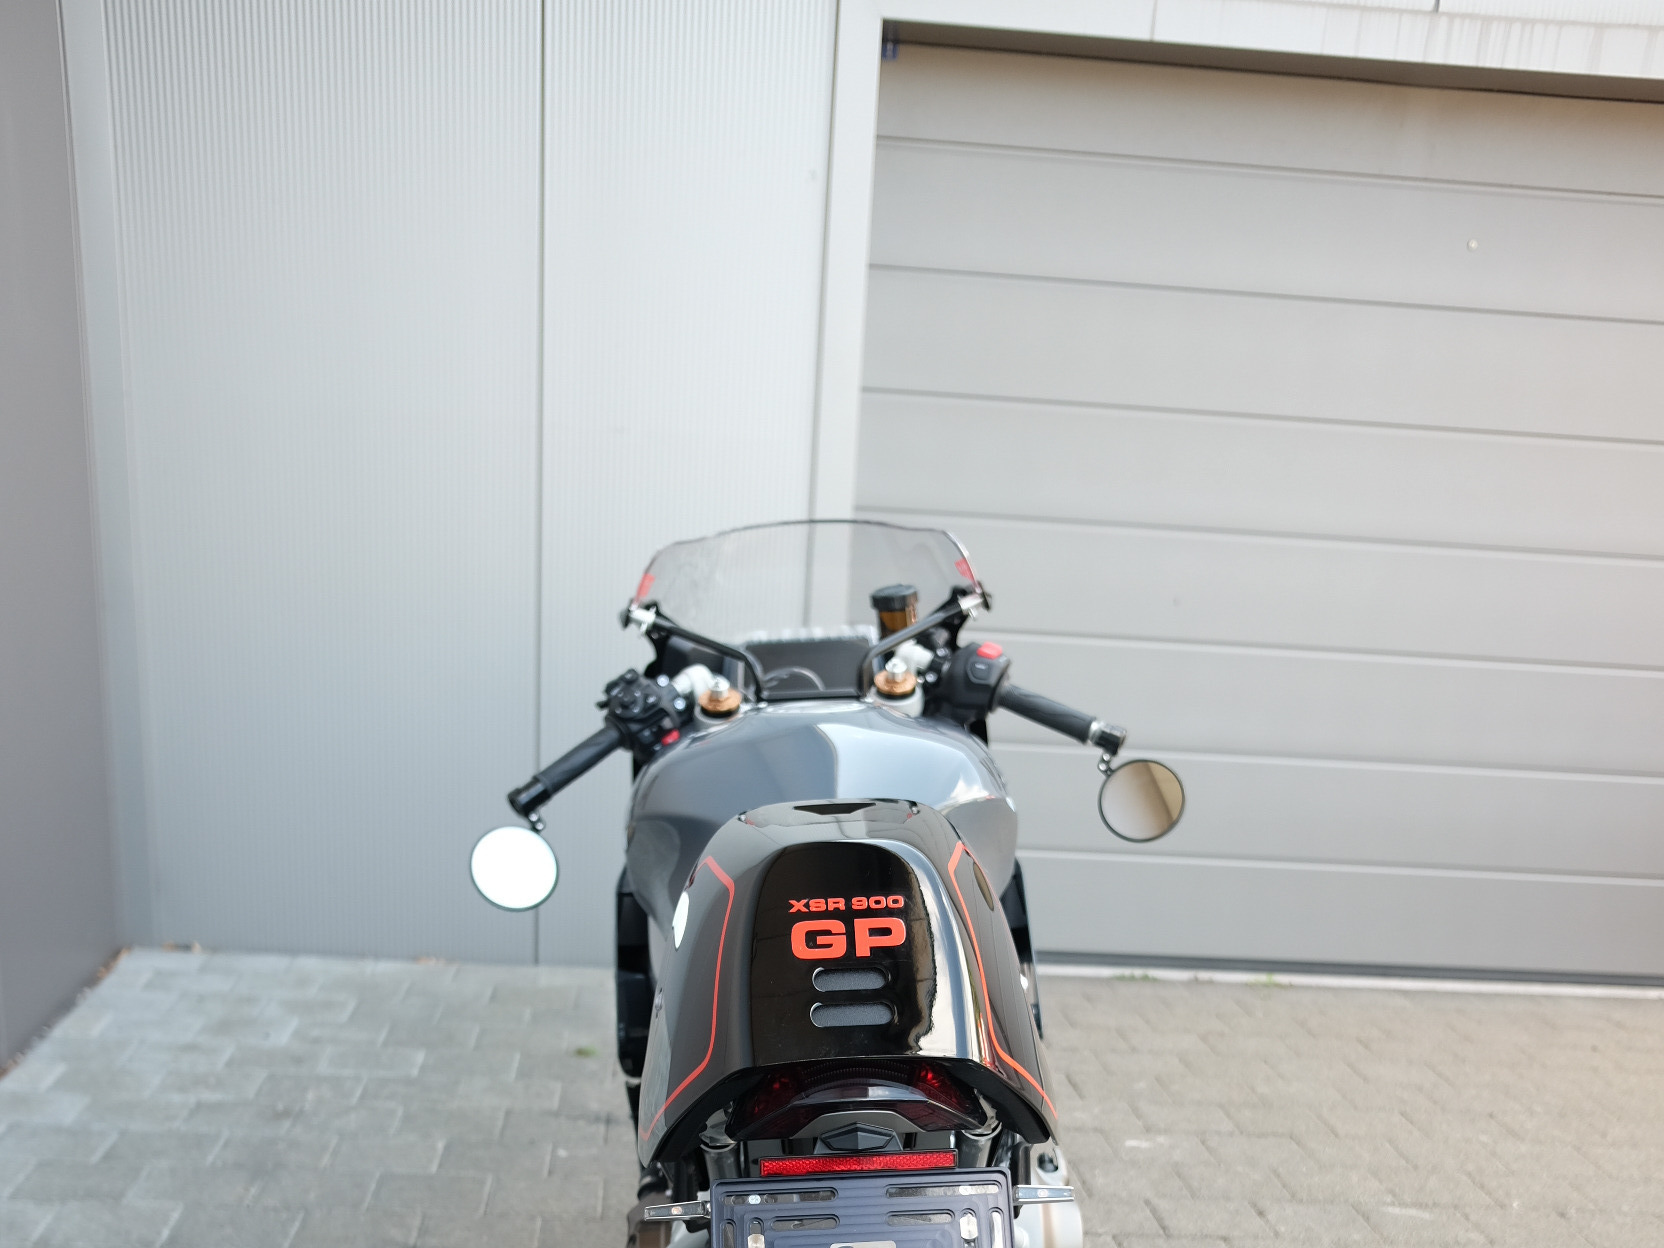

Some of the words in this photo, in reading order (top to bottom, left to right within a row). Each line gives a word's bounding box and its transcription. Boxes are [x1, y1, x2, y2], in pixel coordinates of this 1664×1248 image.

[788, 897, 845, 913] XSR
[851, 895, 904, 910] 900
[791, 917, 907, 960] GP
